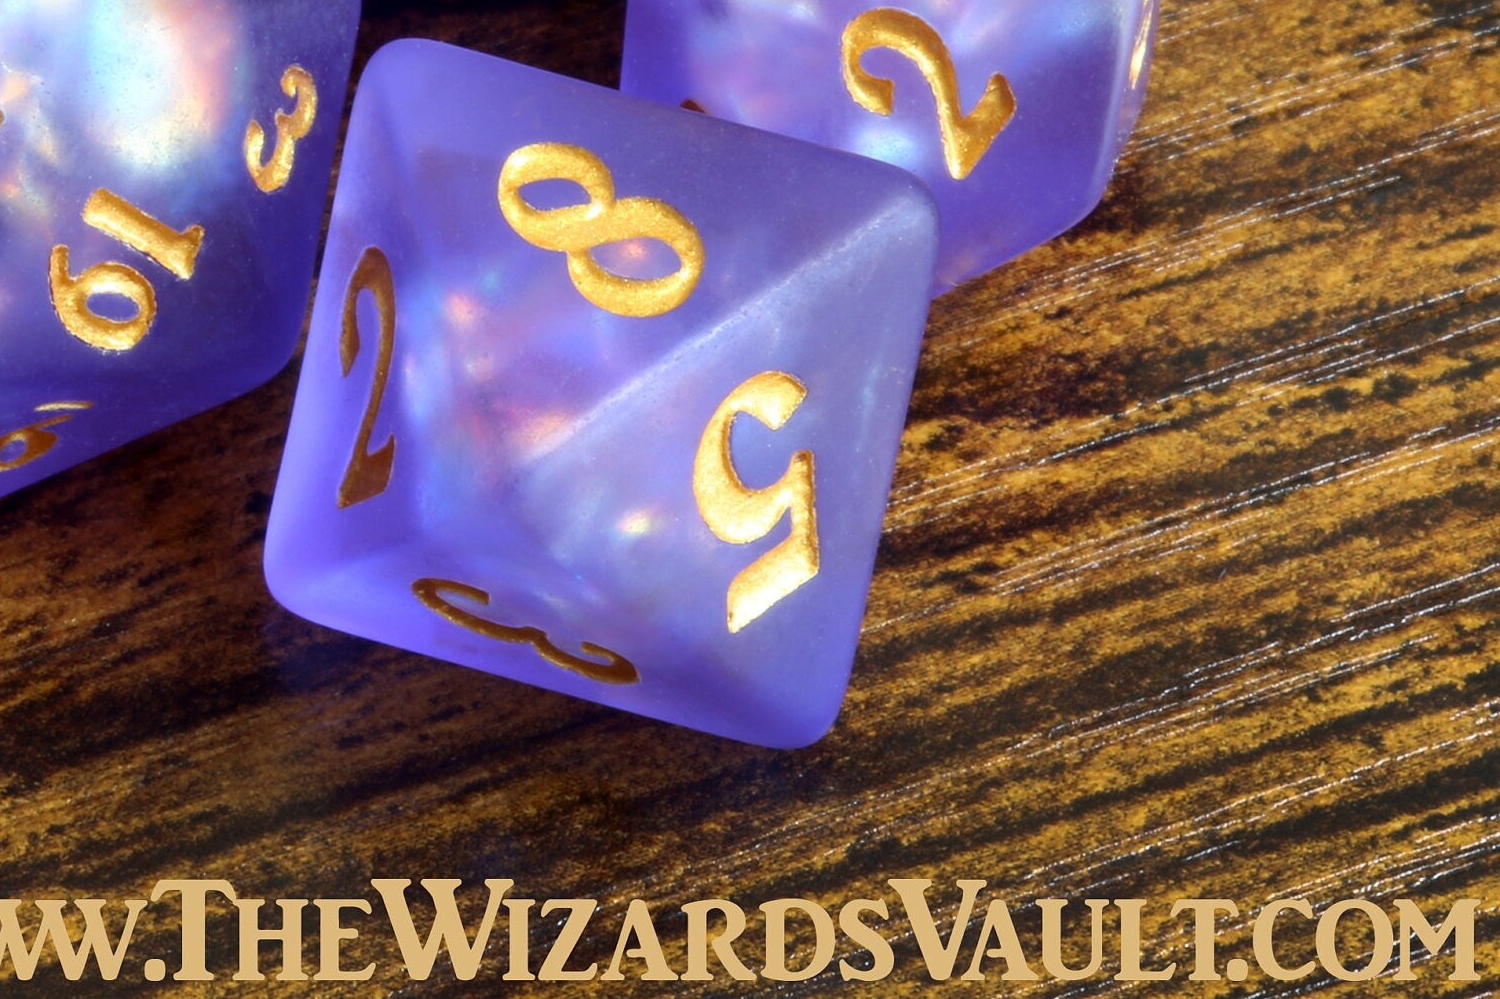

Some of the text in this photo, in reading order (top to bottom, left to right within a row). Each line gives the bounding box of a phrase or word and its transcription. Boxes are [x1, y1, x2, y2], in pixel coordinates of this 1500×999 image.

[244, 64, 318, 194] 3
[841, 6, 1018, 181] 2
[497, 141, 705, 318] 8
[337, 245, 397, 510] 2
[692, 369, 820, 634] 5
[411, 576, 641, 685] 3
